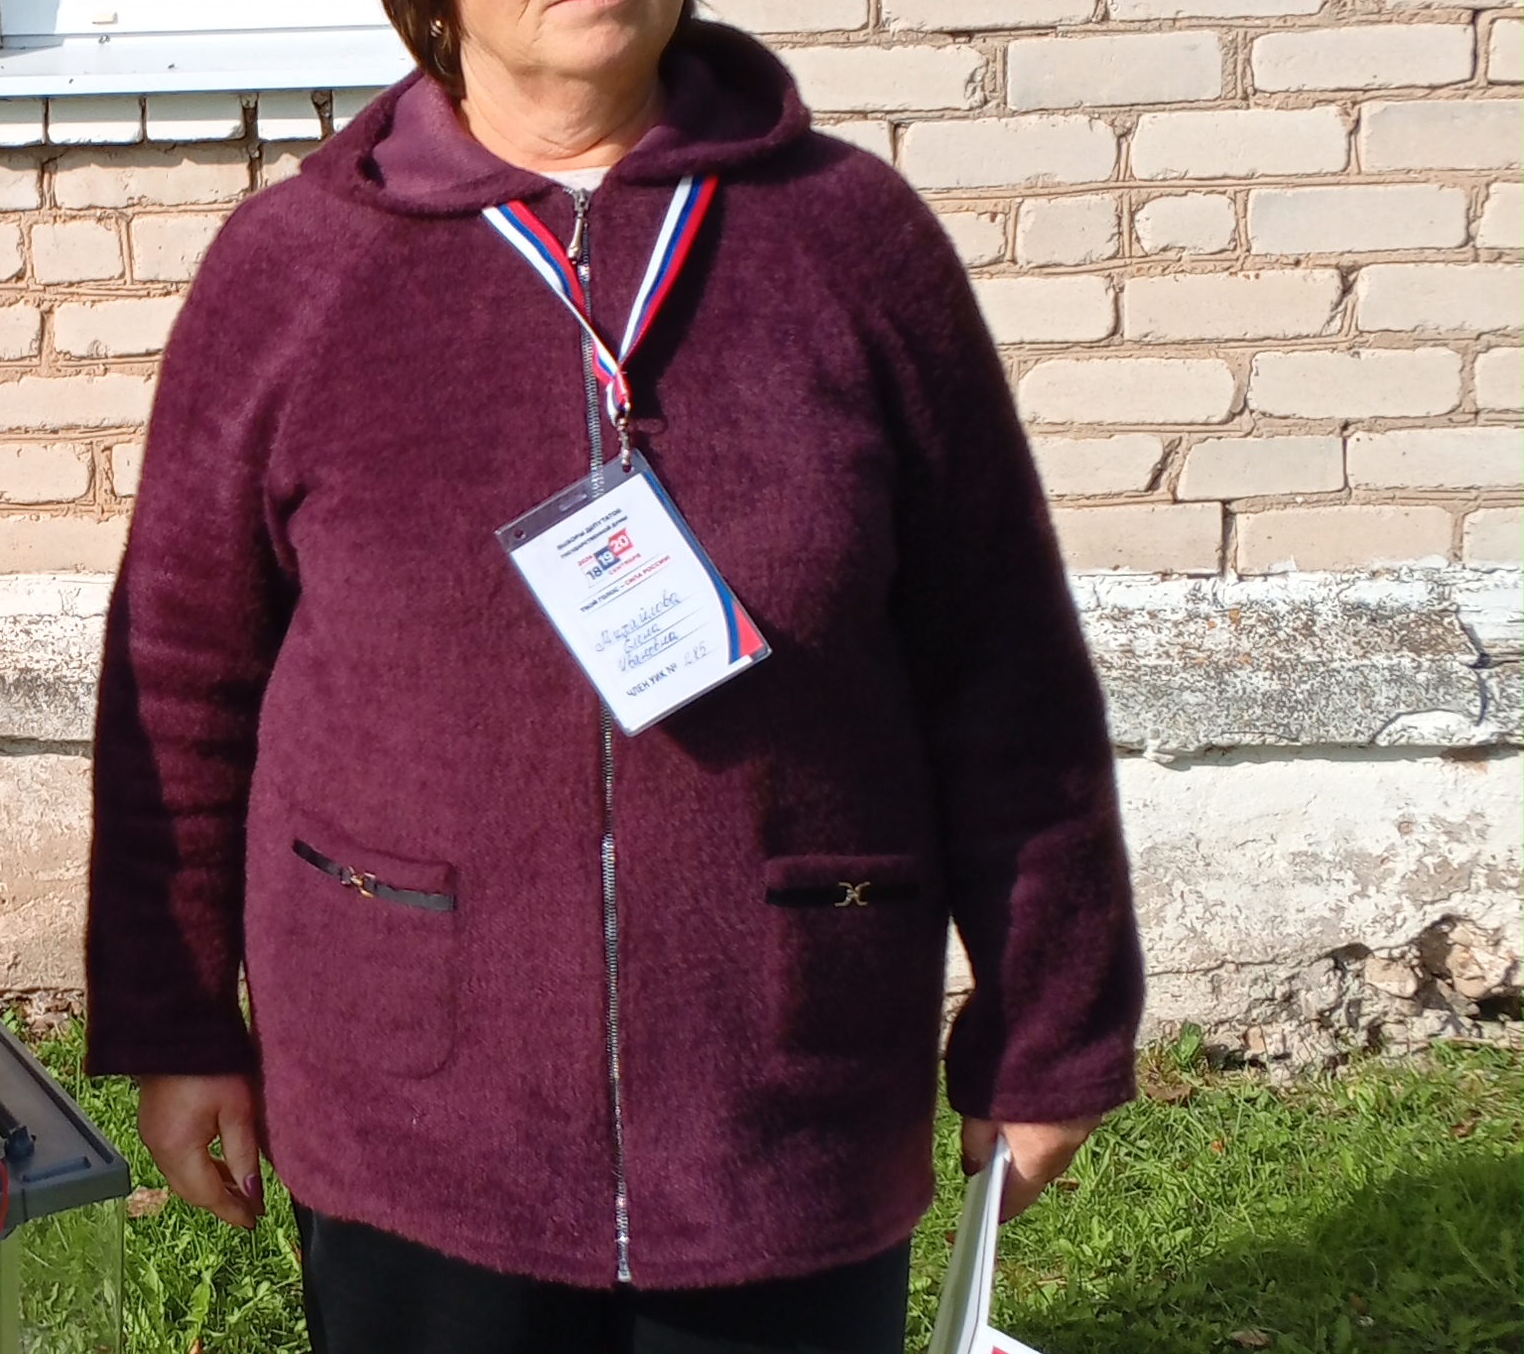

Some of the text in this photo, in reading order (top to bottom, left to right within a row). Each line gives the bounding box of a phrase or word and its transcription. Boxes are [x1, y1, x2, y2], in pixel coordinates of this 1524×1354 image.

[585, 508, 622, 534] ДЕПУТАТОВ
[586, 534, 631, 580] 18 19 20
[598, 588, 619, 601] ГОЛОС
[625, 573, 642, 585] СИЛА
[627, 680, 650, 696] ЧЛЕН
[649, 670, 667, 685] УИК
[666, 663, 677, 673] №
